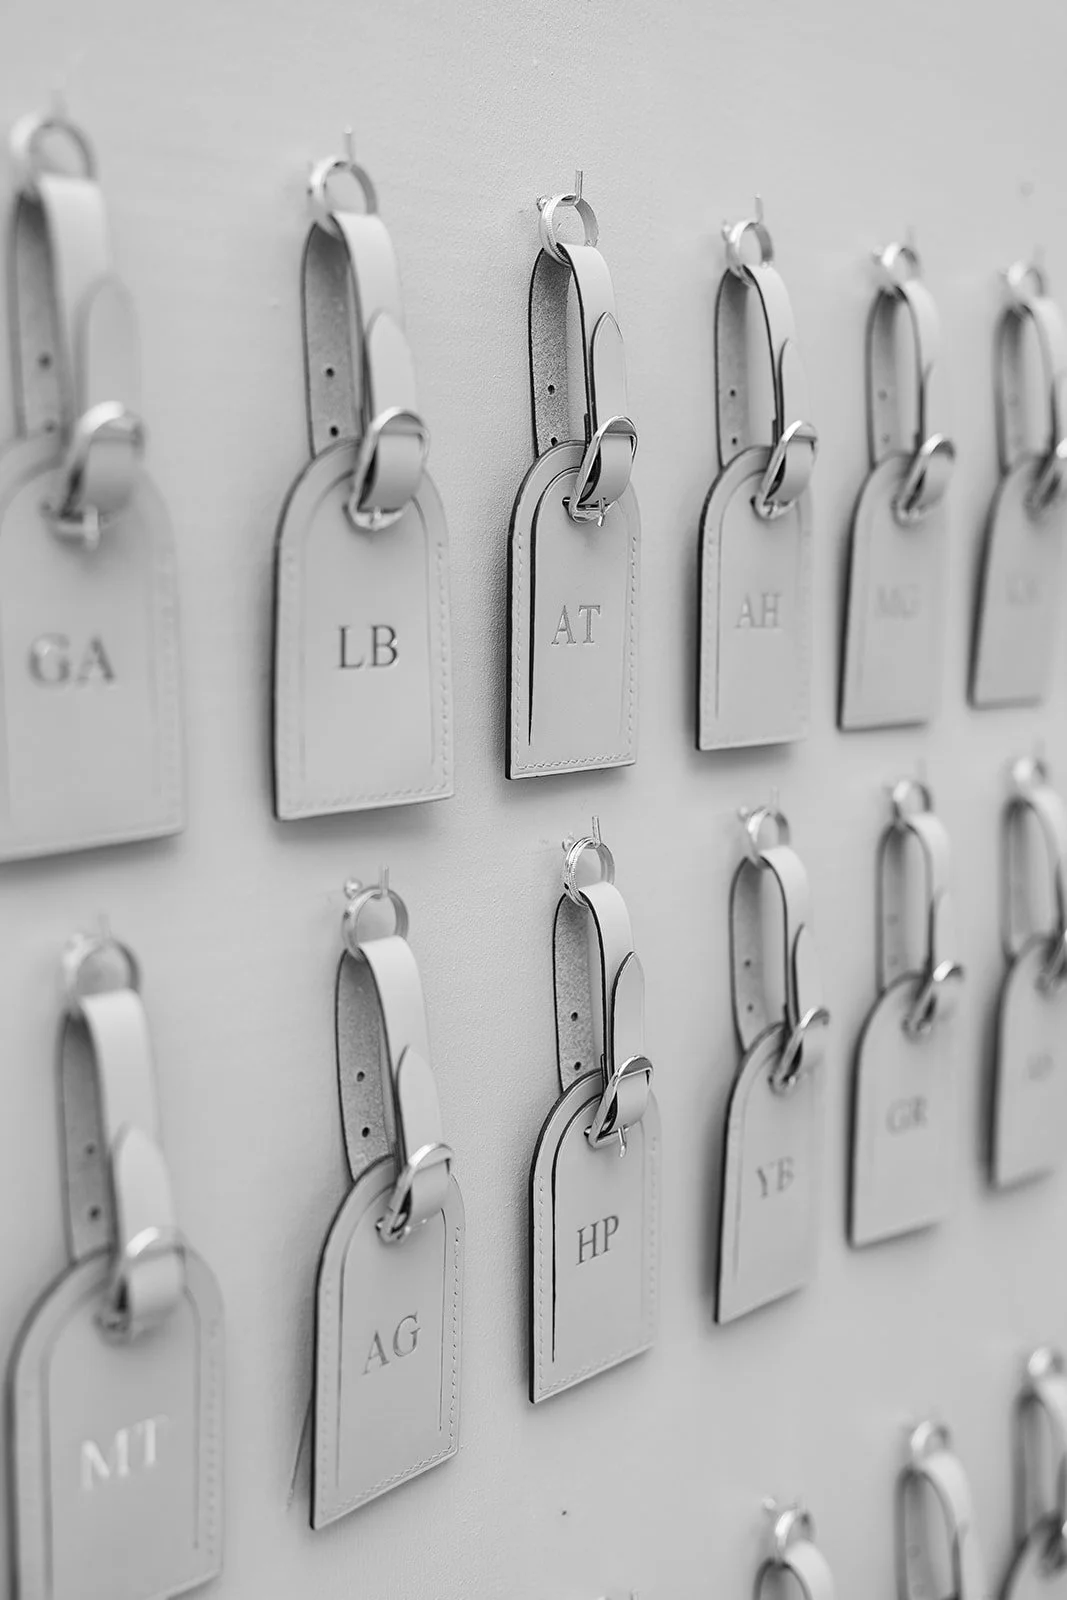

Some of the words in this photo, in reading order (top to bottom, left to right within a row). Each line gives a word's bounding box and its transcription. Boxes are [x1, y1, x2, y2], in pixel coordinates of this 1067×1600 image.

[550, 604, 602, 646] AT
[734, 592, 784, 629] AH
[27, 632, 118, 690] GA
[336, 625, 400, 670] LB
[756, 1156, 795, 1200] YB
[576, 1214, 620, 1266] HP
[361, 1312, 421, 1376] AG
[80, 1412, 170, 1495] MT
